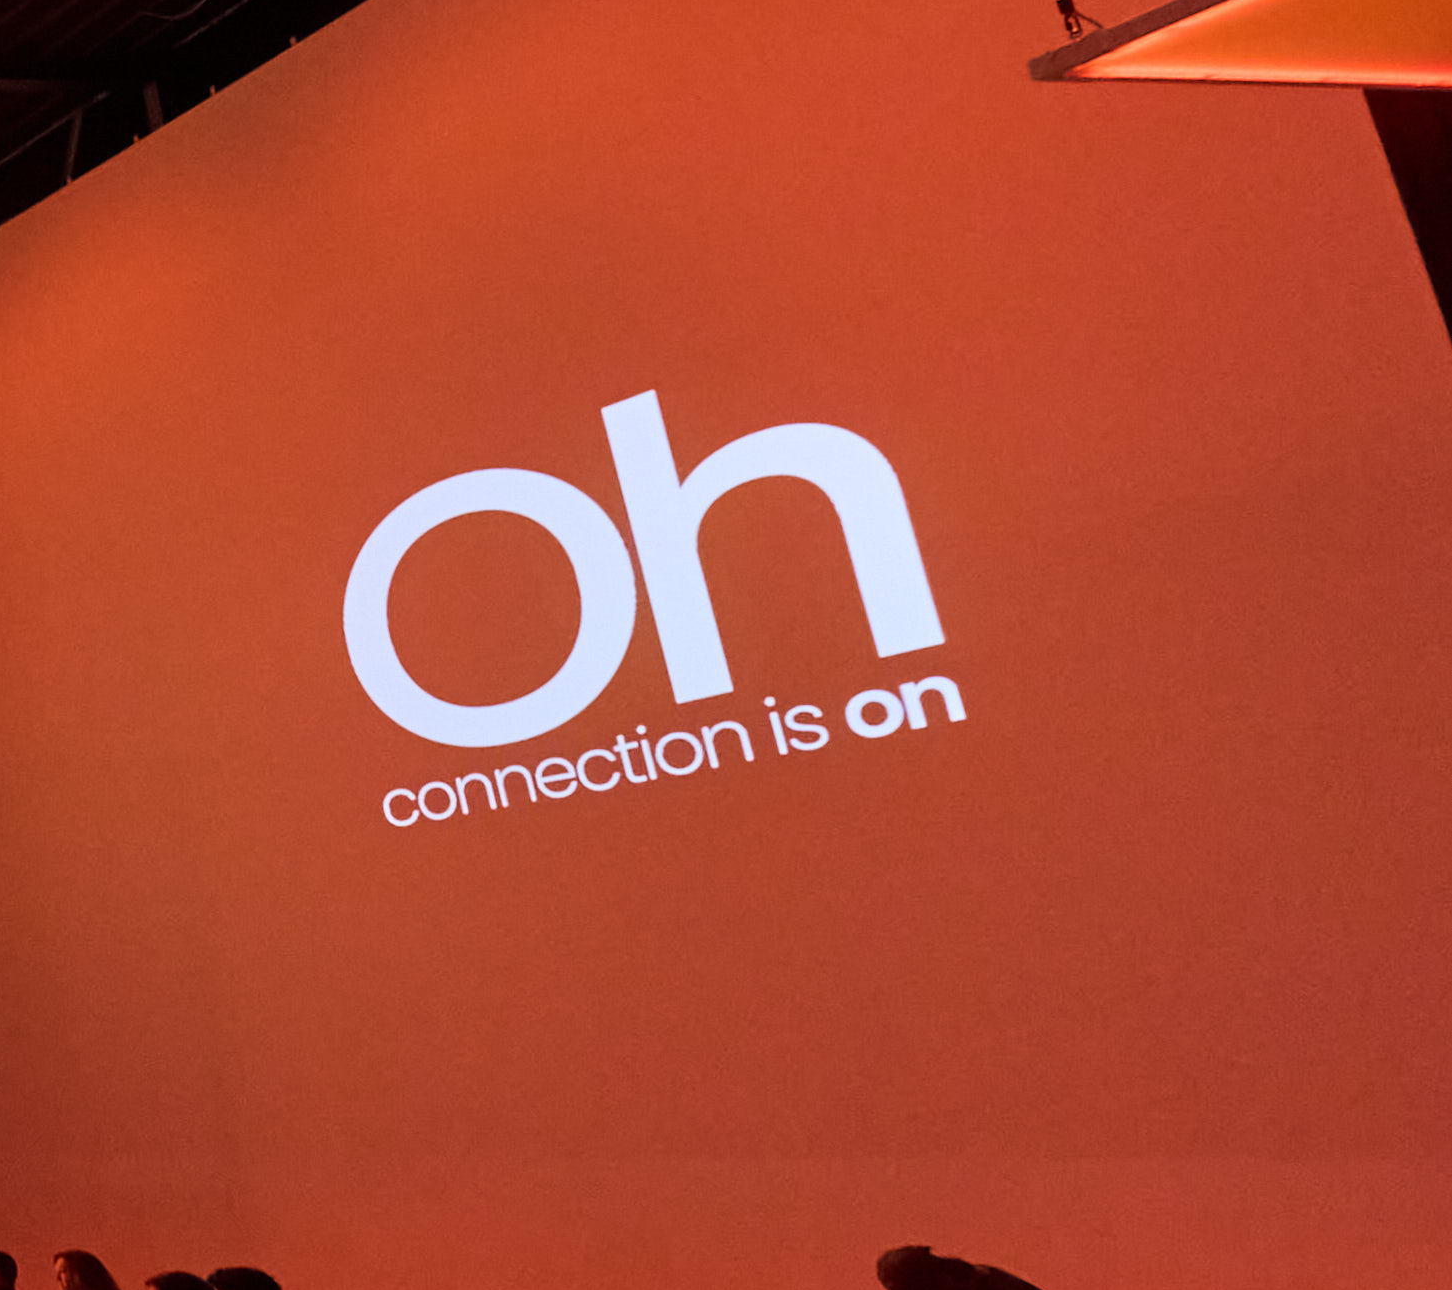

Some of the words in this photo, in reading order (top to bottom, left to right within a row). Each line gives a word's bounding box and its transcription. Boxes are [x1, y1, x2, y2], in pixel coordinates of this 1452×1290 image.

[342, 389, 946, 748] Oh
[382, 720, 755, 827] connection
[763, 696, 830, 755] is
[844, 675, 967, 739] on
